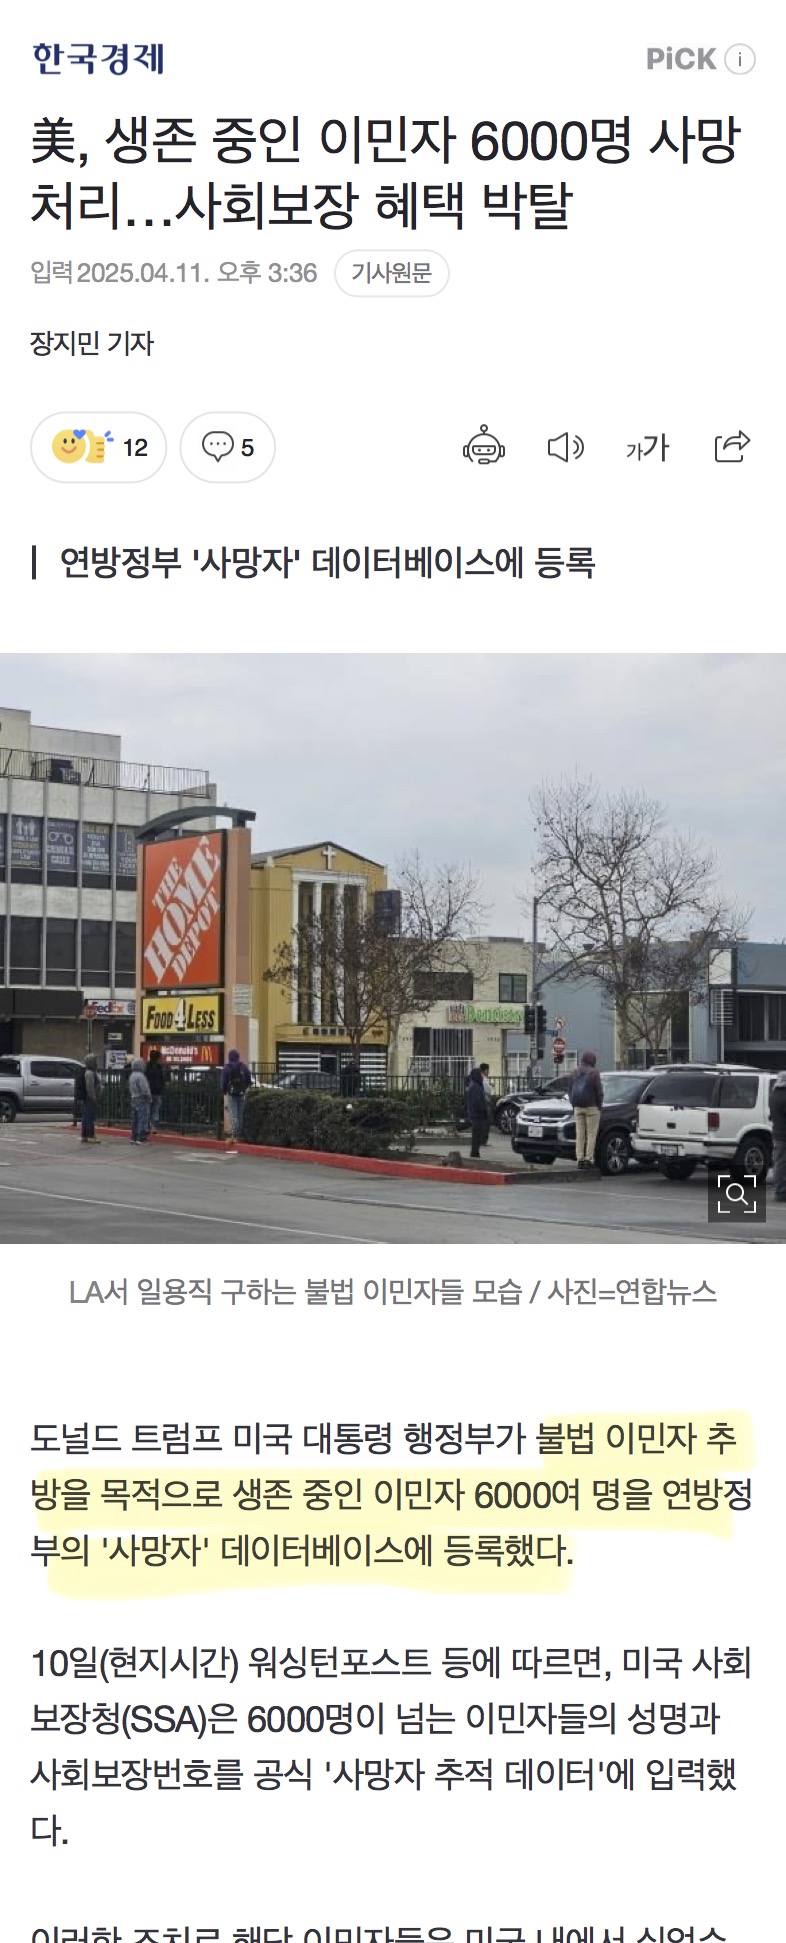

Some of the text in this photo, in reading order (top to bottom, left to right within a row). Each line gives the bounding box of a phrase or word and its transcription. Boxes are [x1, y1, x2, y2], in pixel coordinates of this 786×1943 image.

[33, 43, 163, 75] 한국경제
[647, 46, 717, 70] PiCK
[32, 116, 741, 168] 美, 생존 중인 이민자 6000명 사망
[376, 182, 462, 230] 혜택
[484, 182, 573, 230] 박탈
[31, 261, 318, 284] 입력 2025.04.11. 오후 3:36
[352, 261, 433, 285] 기사원문
[30, 331, 154, 356] 장지민 기자
[124, 439, 148, 457] 12
[242, 439, 254, 457] 5
[61, 547, 595, 579] 연방정부 '사망자' 데이터베이스에 등록
[152, 856, 183, 913] THE
[143, 836, 220, 984] HOME
[171, 886, 219, 983] DEPOT
[174, 998, 186, 1031] 4
[70, 1278, 127, 1305] LA서
[138, 1278, 211, 1305] 일용직
[221, 1278, 296, 1305] 구하는
[305, 1278, 353, 1305] 불법
[364, 1278, 464, 1305] 이민자들
[473, 1278, 522, 1305] 모습
[548, 1278, 717, 1305] 사진=연합뉴스
[31, 1423, 736, 1455] 도널드 트럼프 미국 대통령 행정부가 불법 이민자 추
[32, 1479, 752, 1511] 방을 목적으로 생존 중인 이민자 6000여 명을 연방정
[31, 1535, 573, 1567] 부의 '사망자' 데이터베이스에 등록했다.
[33, 1647, 750, 1683] 10일(현지시간) 워싱턴포스트 등에 따르면, 미국 사회
[31, 1703, 720, 1739] 보장청(SSA)은 6000명이 넘는 이민자들의 성명과
[30, 1759, 736, 1791] 사회보장번호를 공식 '사망자 추적 데이터'에 입력했
[32, 1815, 68, 1846] 다.
